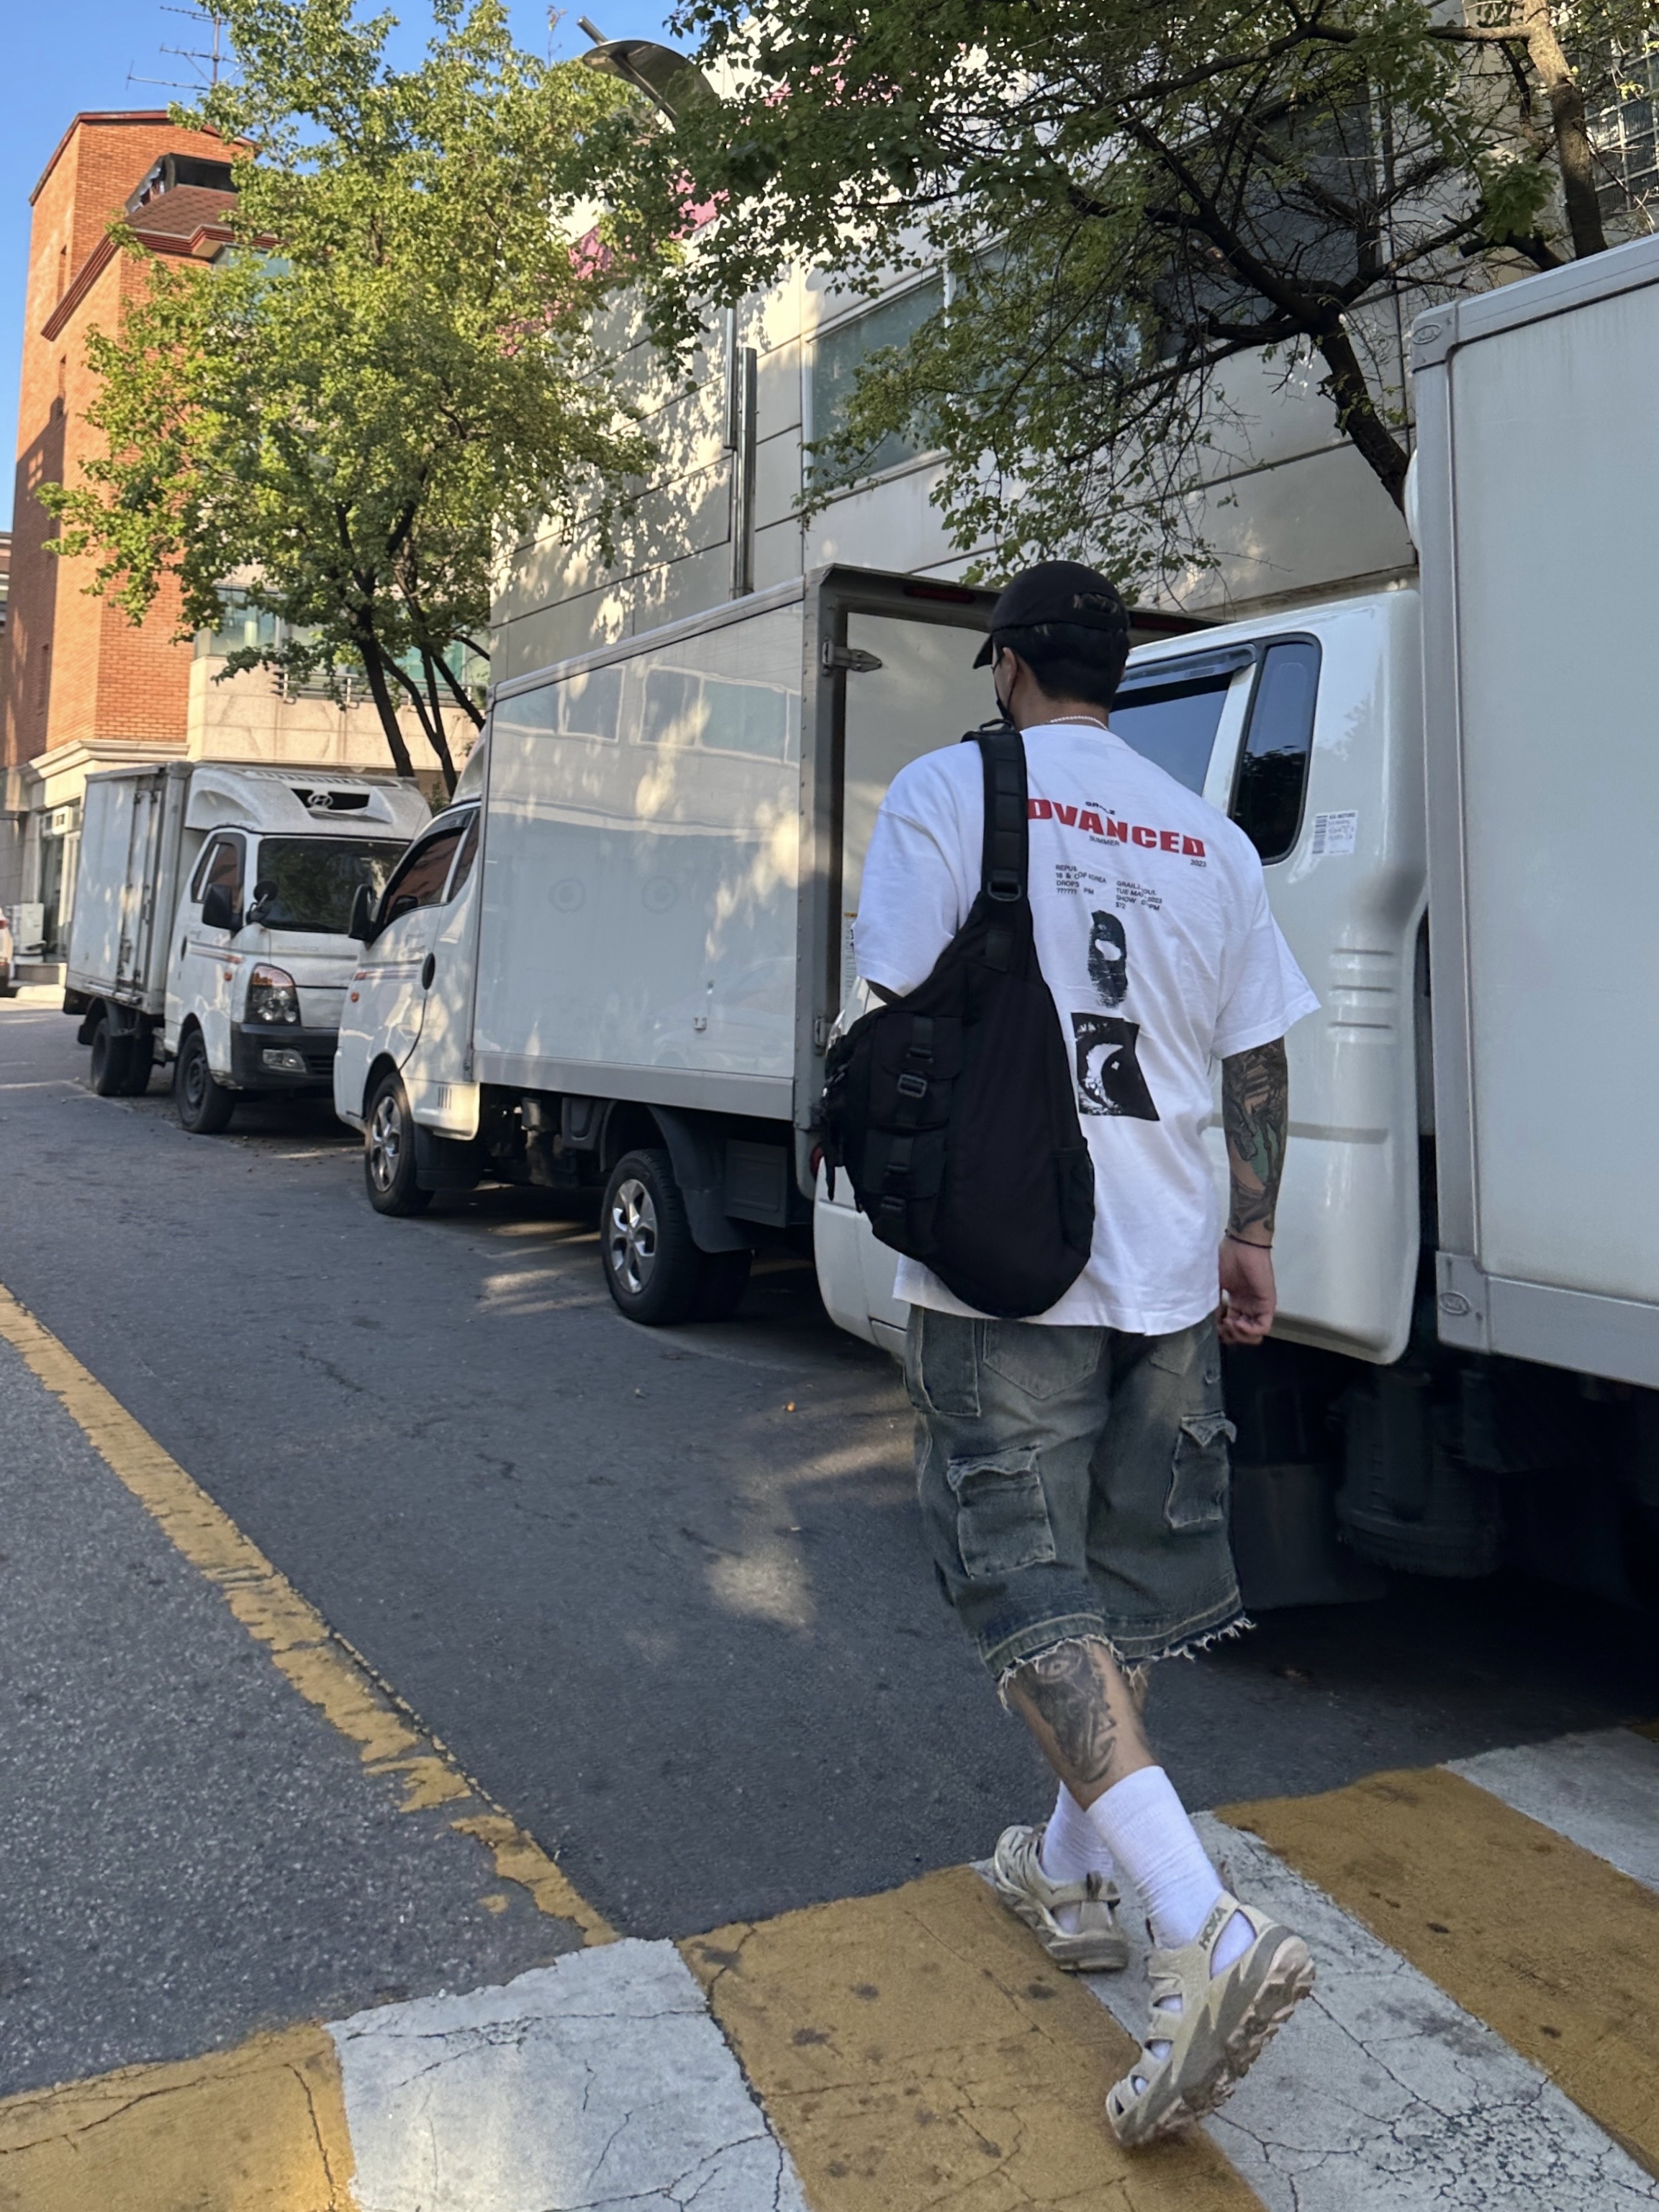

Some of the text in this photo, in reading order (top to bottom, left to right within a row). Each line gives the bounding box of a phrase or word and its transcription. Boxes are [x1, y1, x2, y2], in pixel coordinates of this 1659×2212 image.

[1028, 798, 1206, 857] DVANCED
[1089, 835, 1119, 847] SUMMER
[1116, 895, 1136, 903] SHOW
[1198, 1906, 1228, 1951] HOKA
